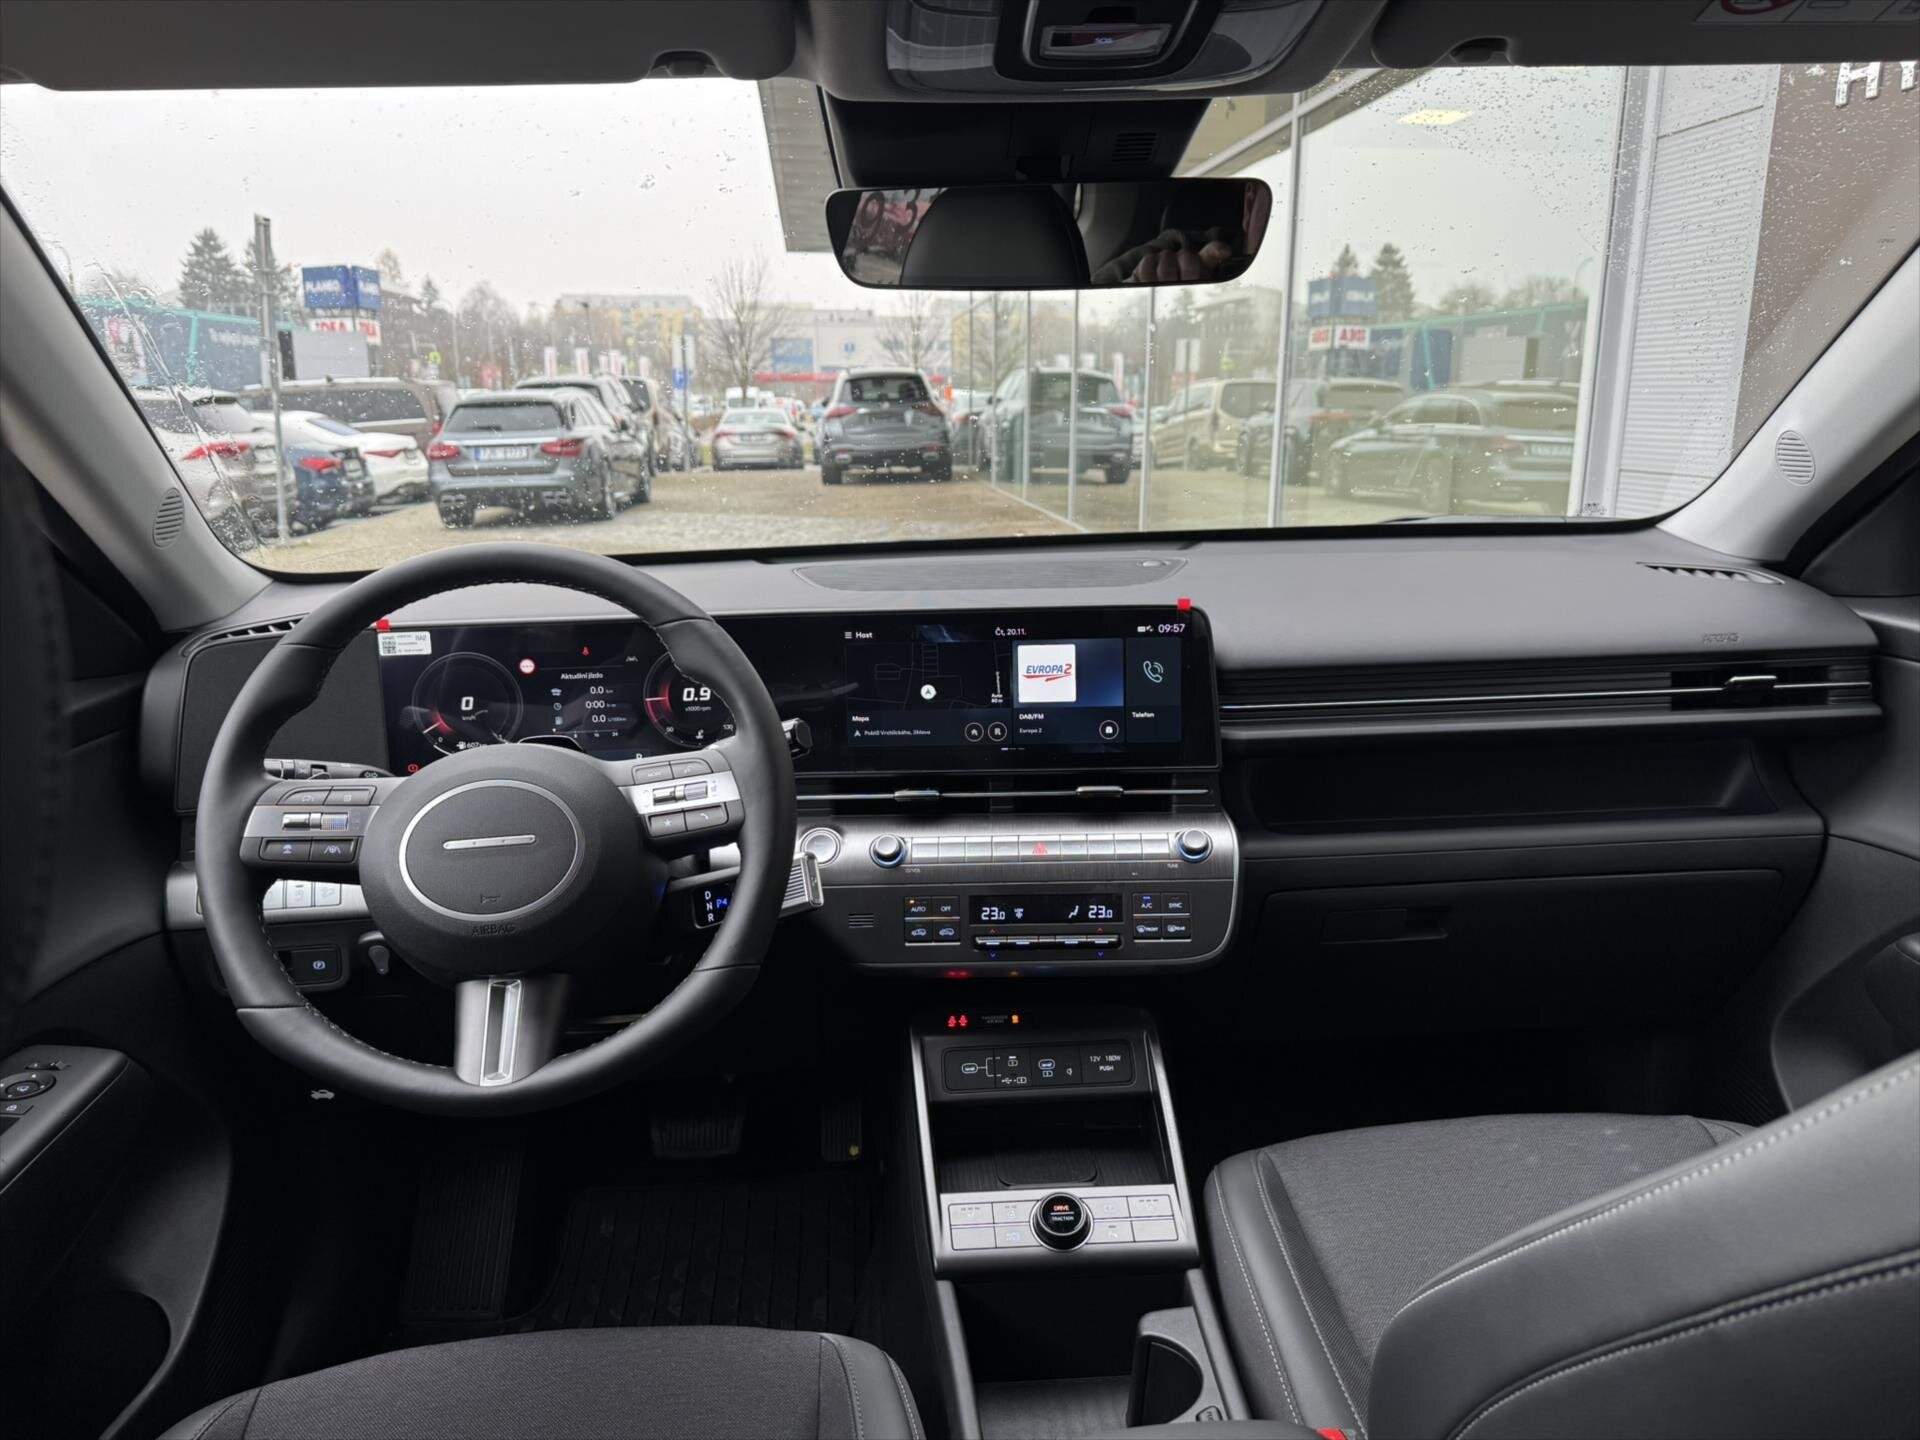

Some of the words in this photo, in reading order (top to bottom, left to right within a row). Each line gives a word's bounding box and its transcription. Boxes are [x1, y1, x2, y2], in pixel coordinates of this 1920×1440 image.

[1007, 628, 1027, 636] 20.11.
[1158, 623, 1185, 633] 09:57
[855, 631, 873, 639] Host
[1026, 664, 1063, 674] EVROPA
[1064, 663, 1072, 675] 2
[590, 686, 604, 694] 0.0
[682, 687, 711, 701] 0.9
[461, 696, 474, 710] 0
[585, 700, 605, 708] 0:00
[592, 714, 606, 722] 0.0
[704, 890, 711, 900] D
[706, 901, 713, 911] N
[981, 907, 1006, 920] 23.0
[1088, 905, 1113, 918] 23.0
[707, 913, 714, 922] R
[472, 924, 517, 937] AIRBAG
